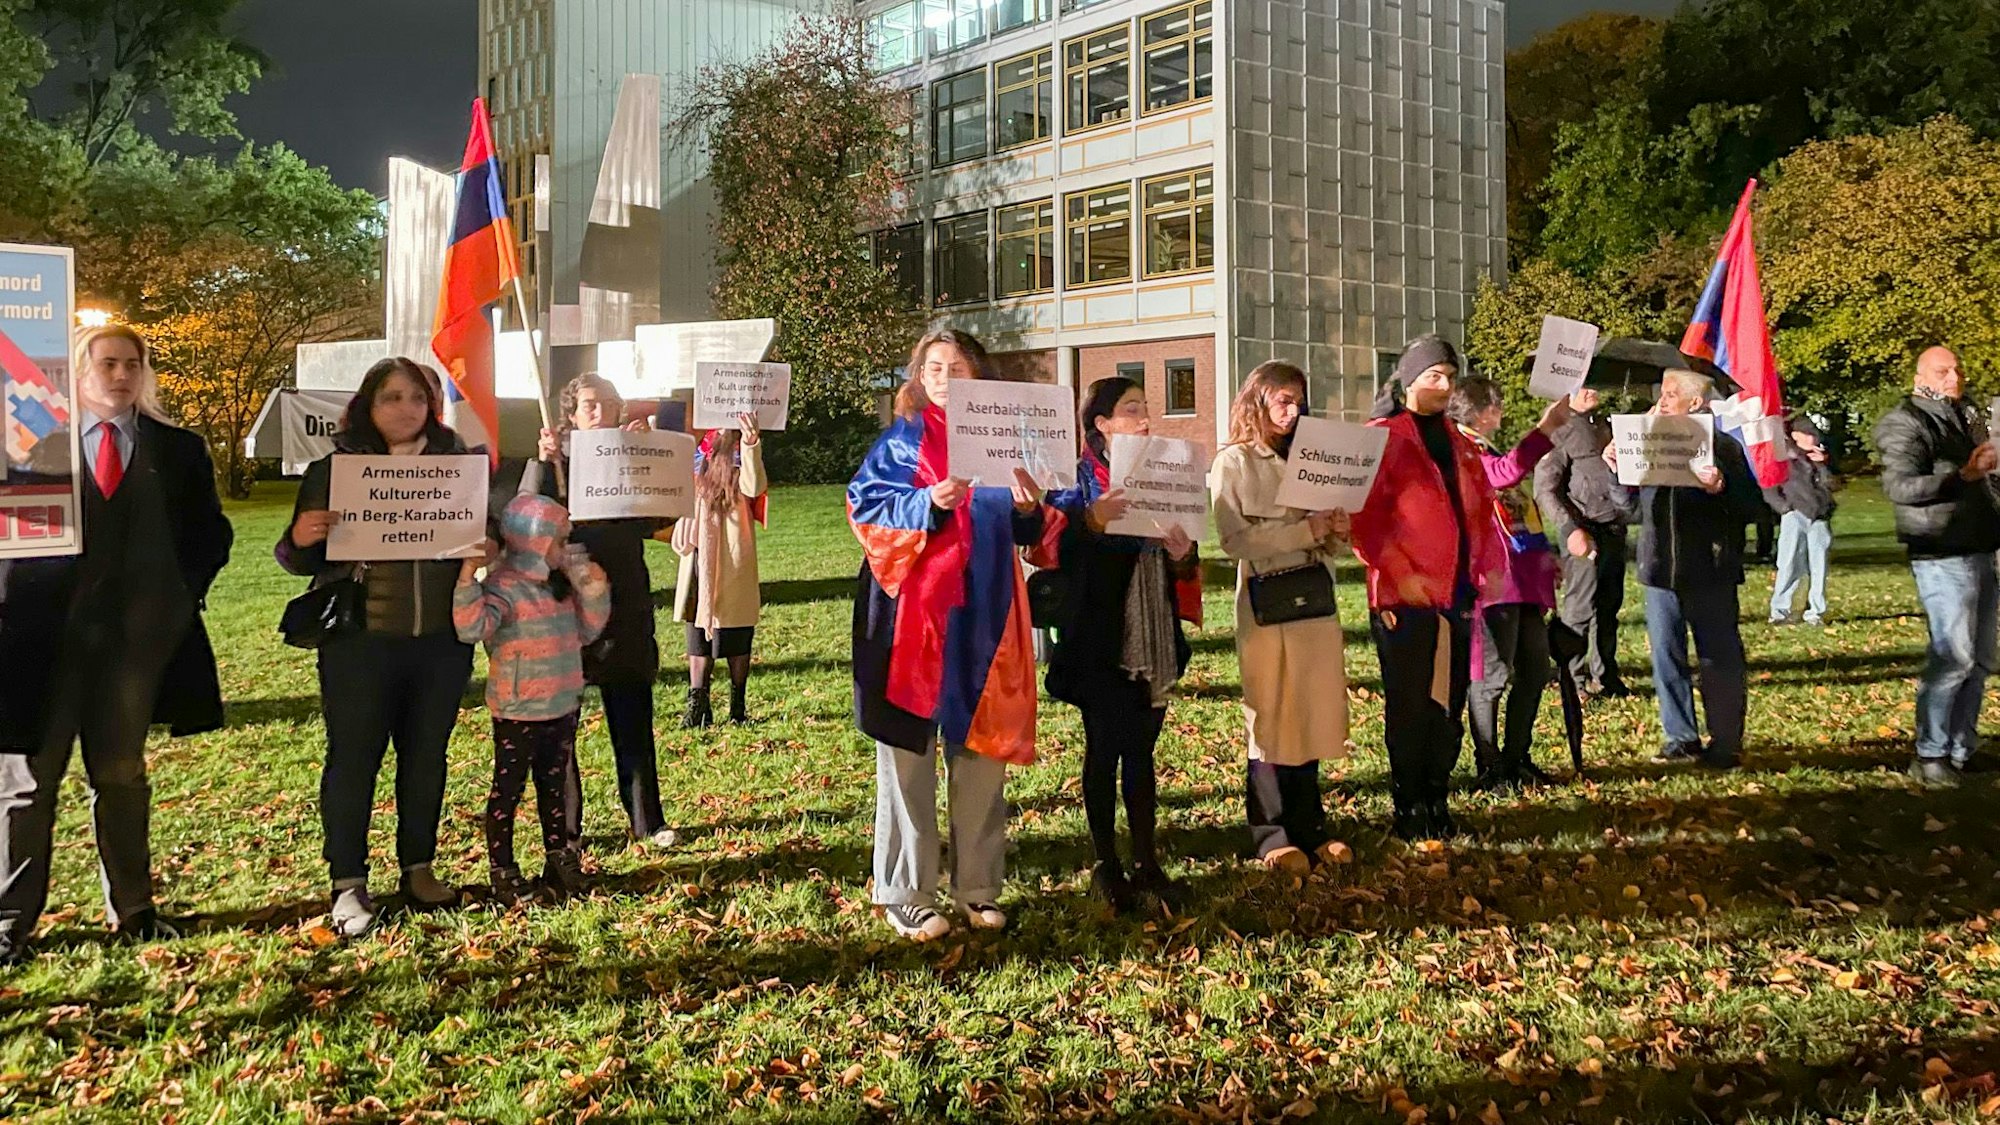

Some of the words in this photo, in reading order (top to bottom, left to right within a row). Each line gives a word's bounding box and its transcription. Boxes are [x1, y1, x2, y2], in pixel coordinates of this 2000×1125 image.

[965, 401, 1057, 418] Aserbaidschan
[956, 425, 989, 436] muss
[992, 425, 1067, 440] sanktioniert
[595, 444, 674, 458] Sanktionen
[1299, 448, 1341, 465] Schluss
[362, 465, 461, 479] Armenisches
[619, 465, 651, 476] statt
[369, 487, 452, 501] Kulturerbe
[343, 509, 357, 522] in
[363, 508, 473, 525] Berg-Karabach
[382, 529, 435, 543] retten!
